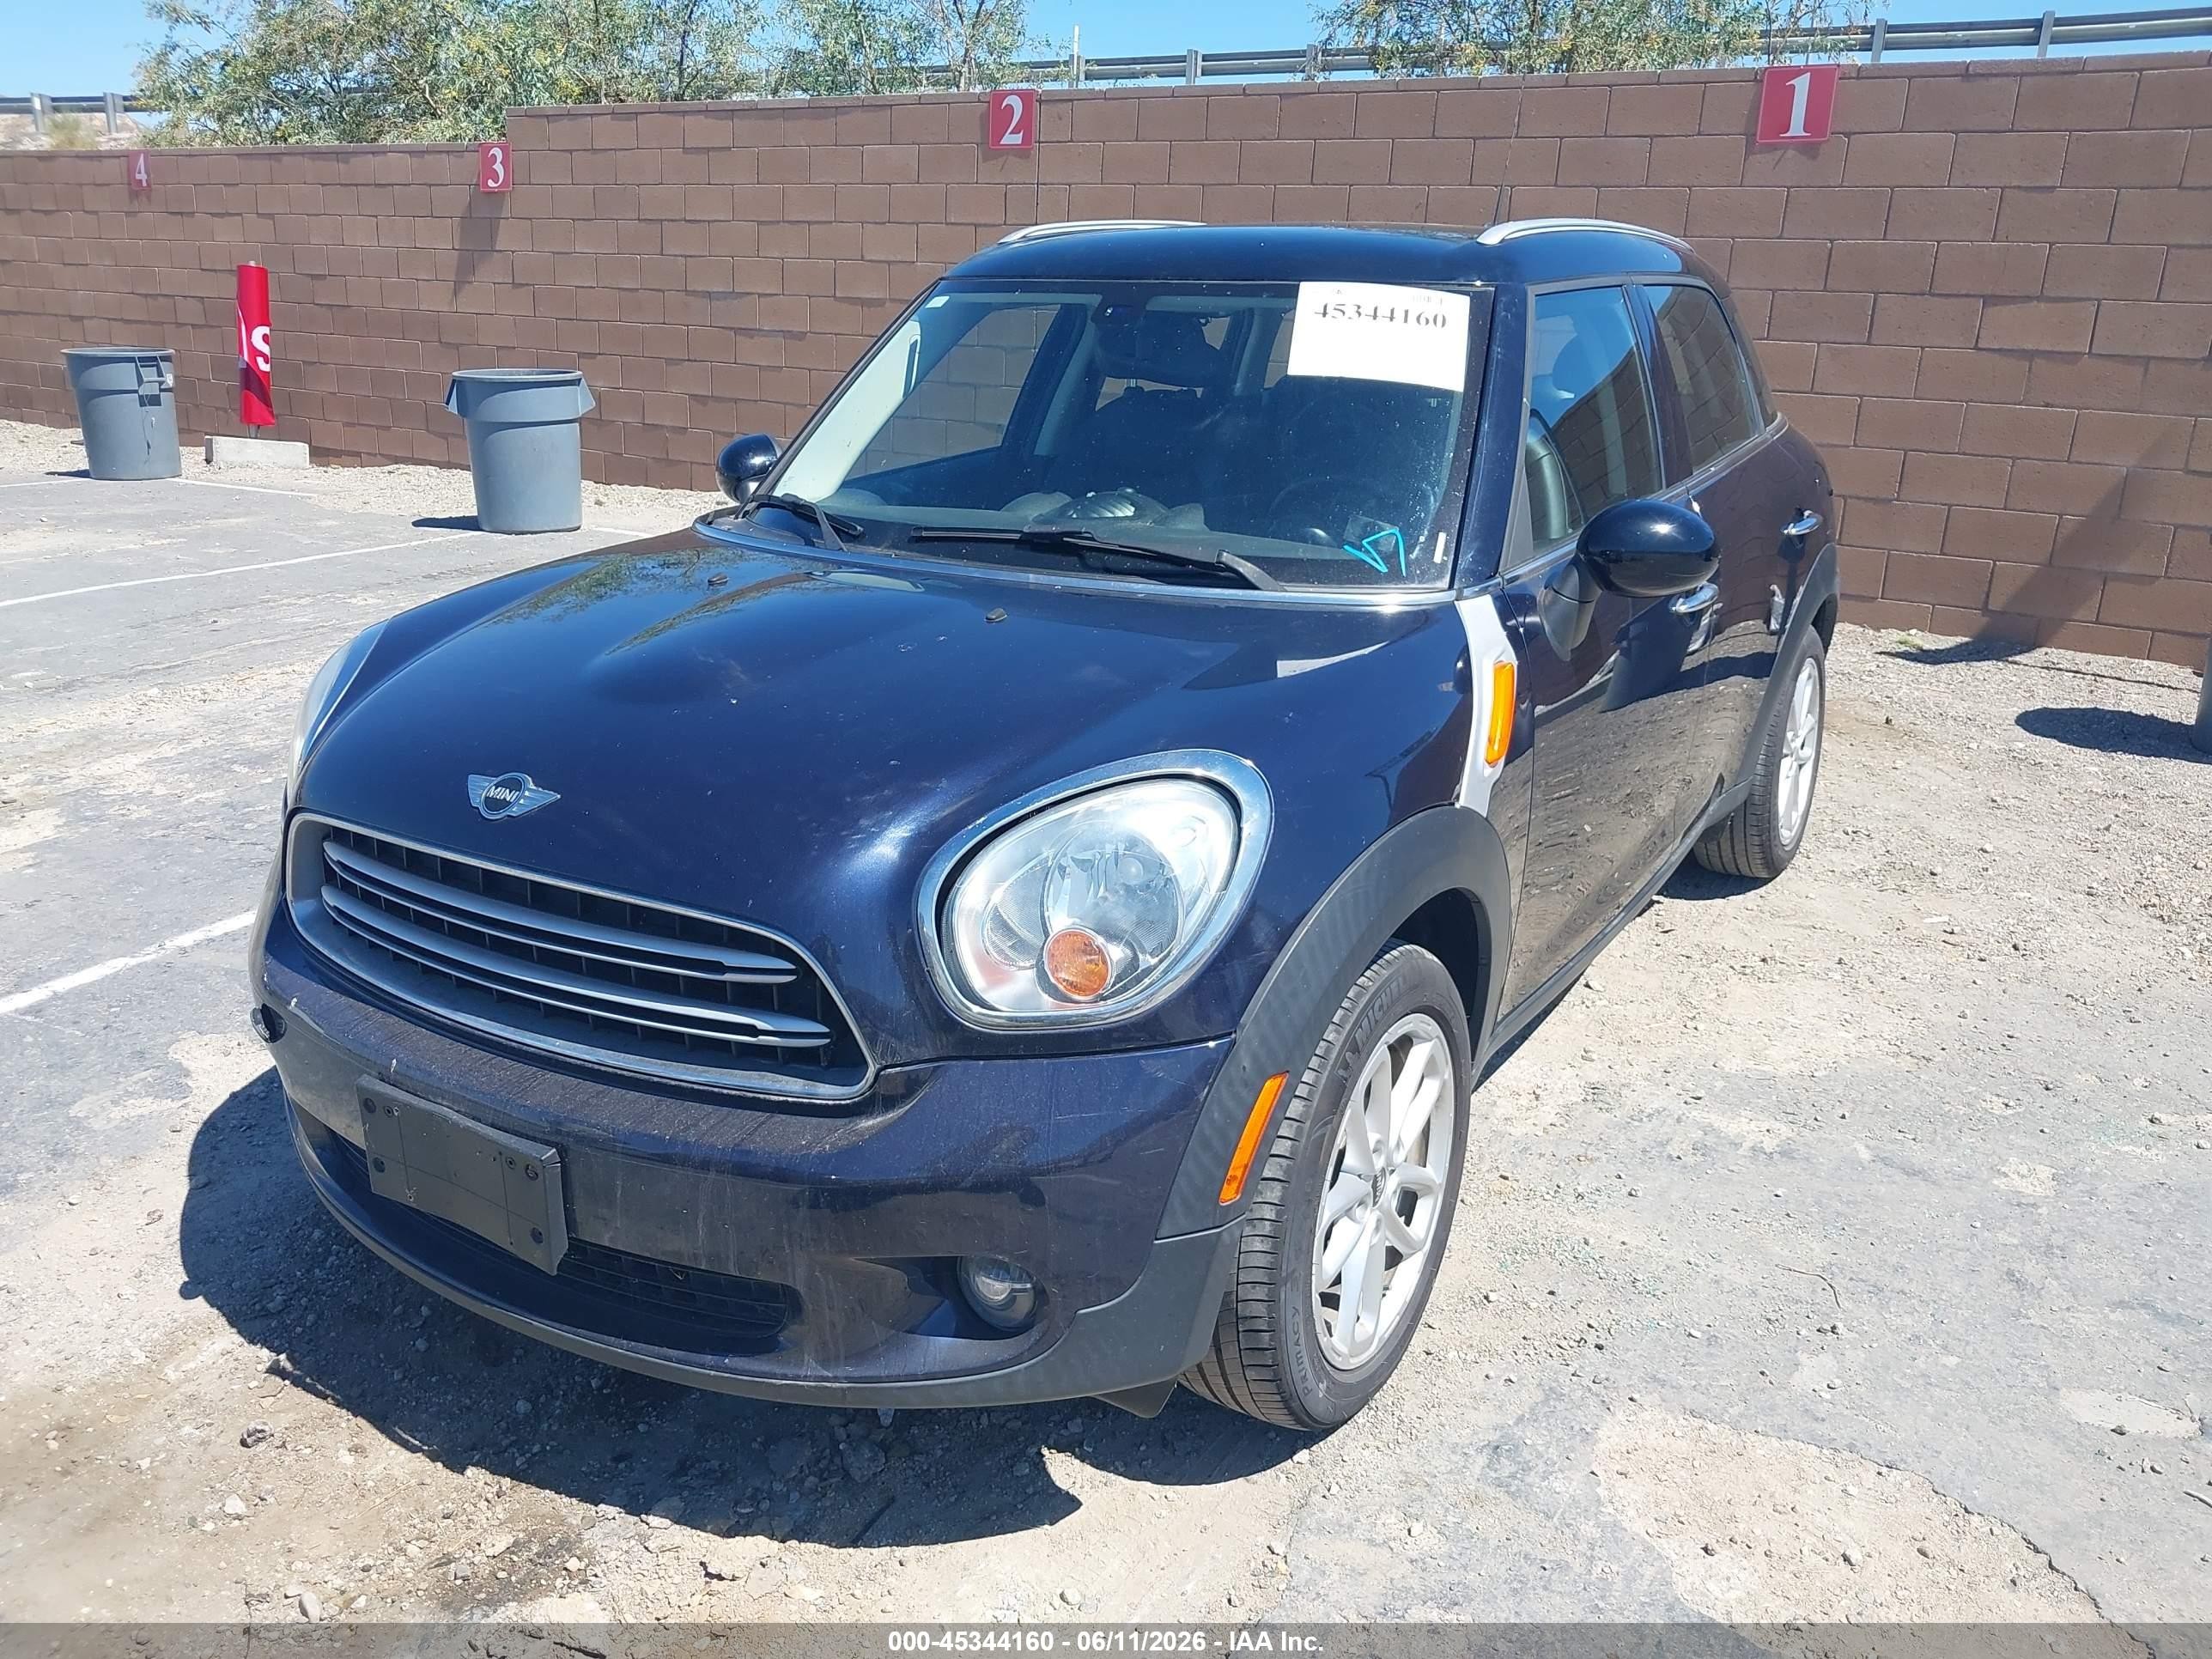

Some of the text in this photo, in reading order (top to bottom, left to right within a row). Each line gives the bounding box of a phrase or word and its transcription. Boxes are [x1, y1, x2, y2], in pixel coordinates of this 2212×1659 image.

[1000, 94, 1024, 144] 2
[1779, 72, 1811, 137] 1
[135, 153, 148, 187] 4
[487, 147, 505, 187] 3
[1313, 302, 1448, 329] 45344160
[486, 785, 520, 803] MINI
[1291, 1306, 1313, 1398] PRIMACY
